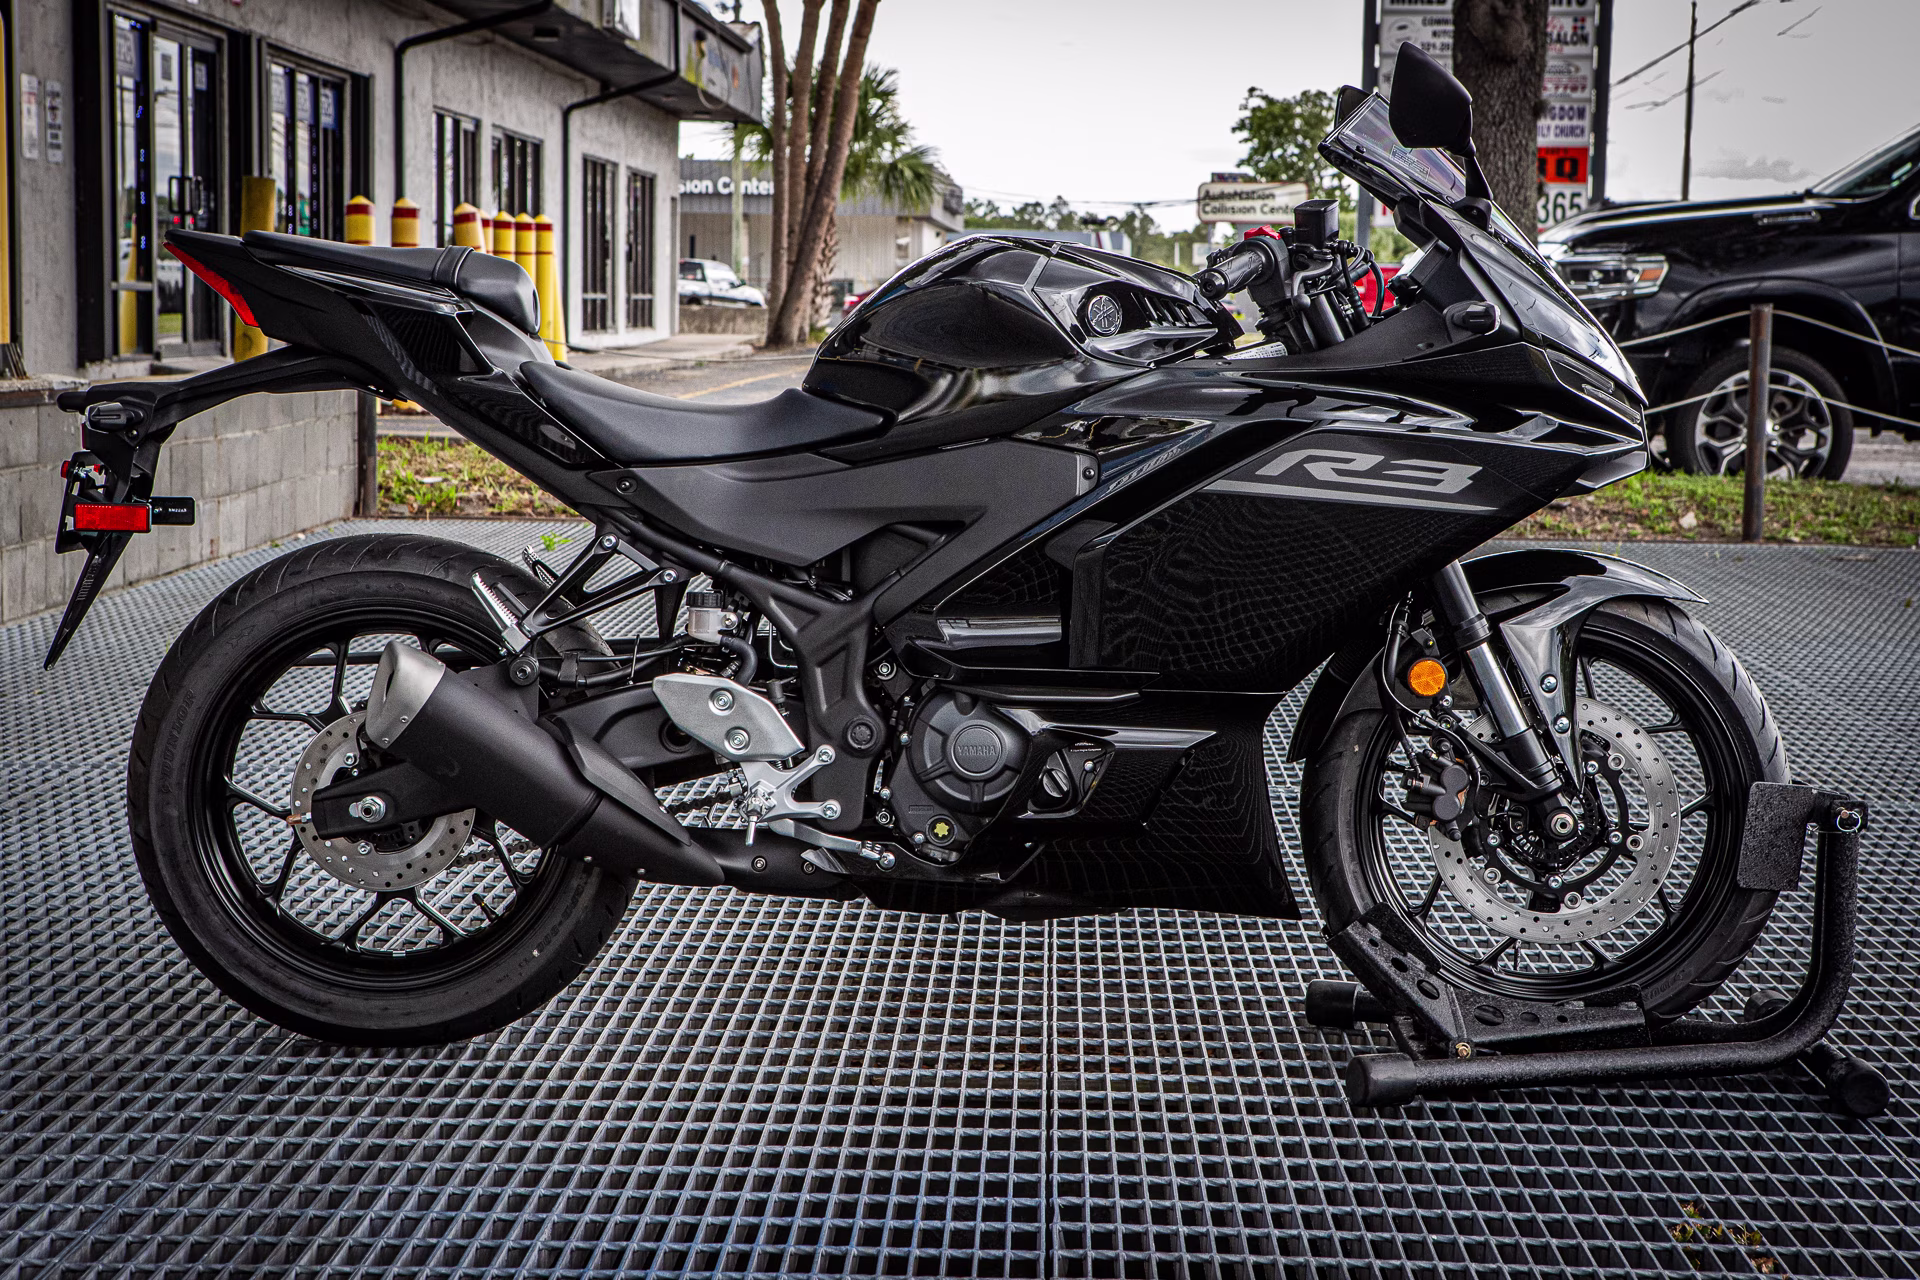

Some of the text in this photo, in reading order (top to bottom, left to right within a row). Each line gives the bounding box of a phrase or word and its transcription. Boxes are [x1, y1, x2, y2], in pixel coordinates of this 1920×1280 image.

[1536, 124, 1585, 138] ILY CHURCH
[1202, 203, 1294, 215] Collision Cent
[1537, 192, 1582, 224] 365
[1255, 448, 1483, 494] R3
[957, 744, 997, 757] YAMAHA
